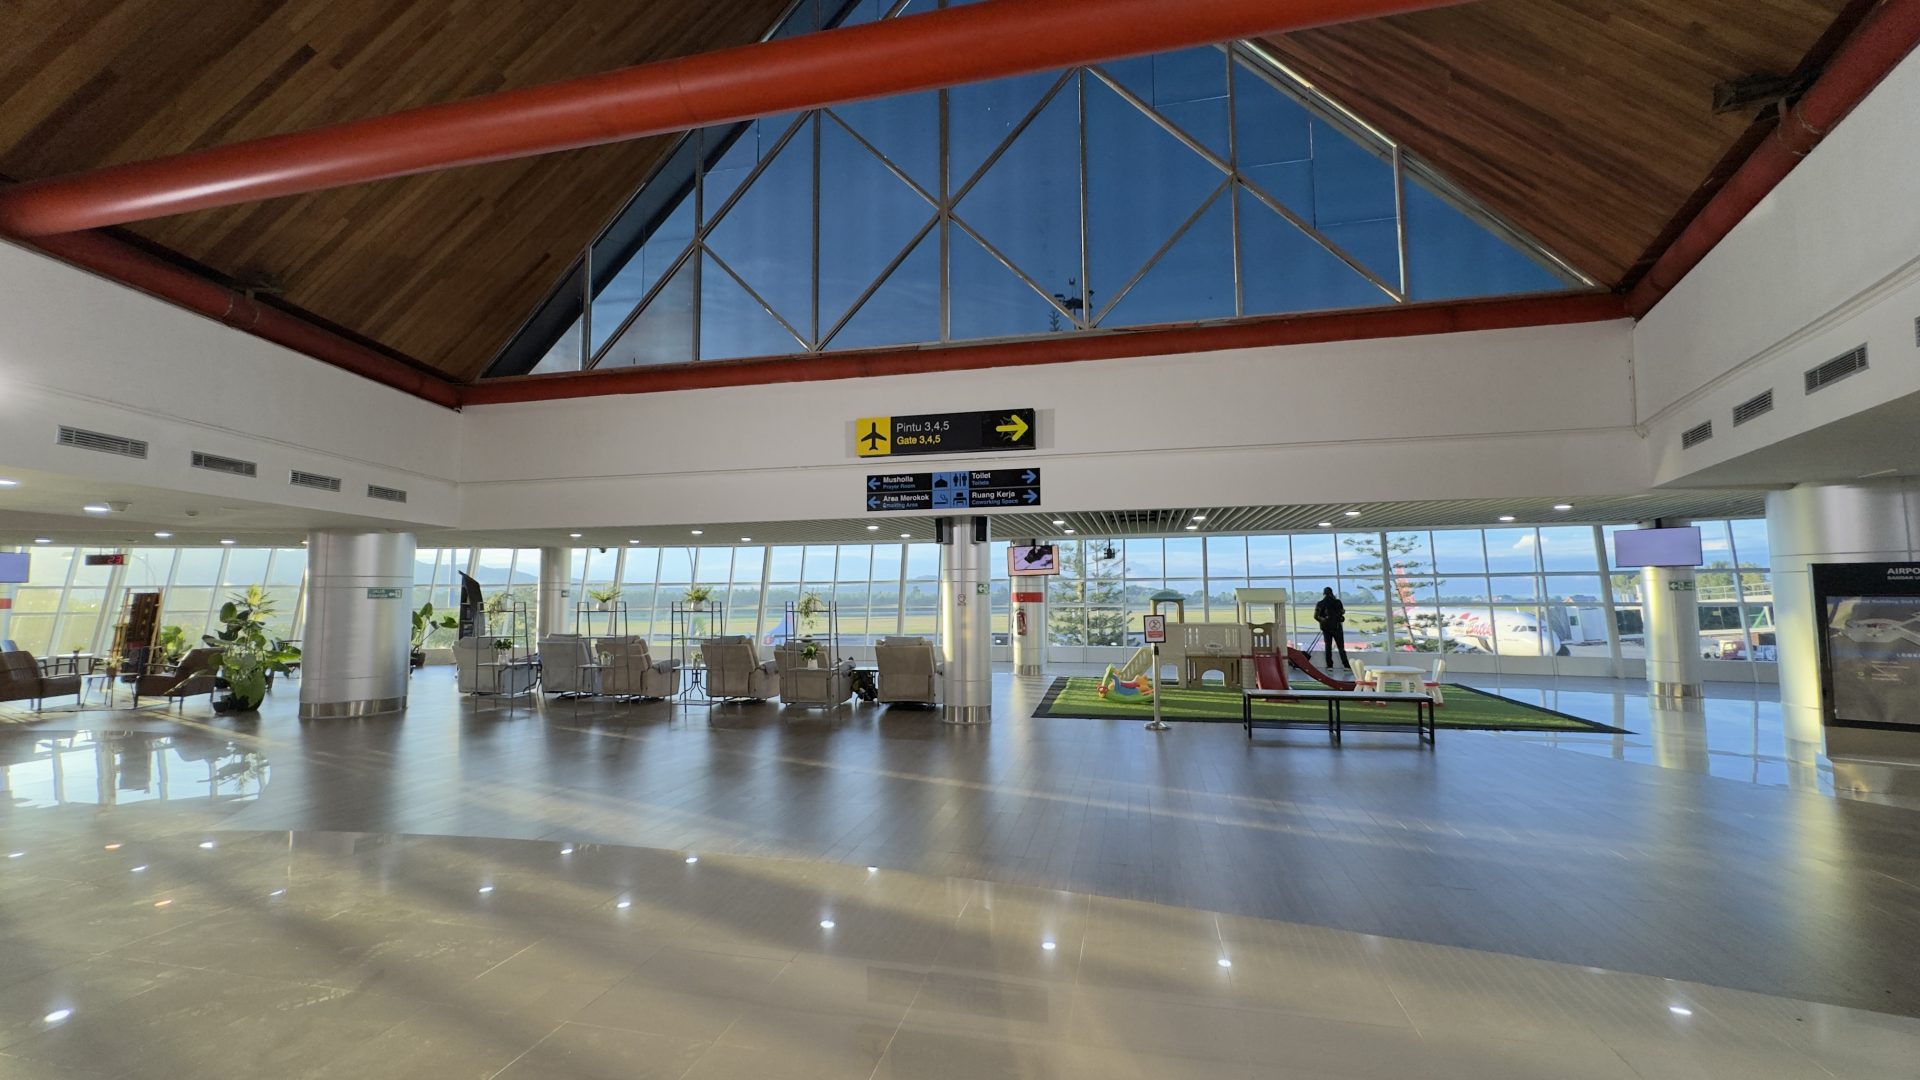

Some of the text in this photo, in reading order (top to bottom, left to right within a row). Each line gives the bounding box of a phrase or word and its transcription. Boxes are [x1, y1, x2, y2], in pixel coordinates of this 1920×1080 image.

[896, 420, 950, 433] Pintu 3,4,5
[896, 434, 941, 445] Gate 3,4,5
[882, 475, 914, 483] Musholla
[971, 472, 992, 480] Toilet
[900, 493, 930, 502] Merokok
[971, 490, 1016, 500] Ruang Kerja
